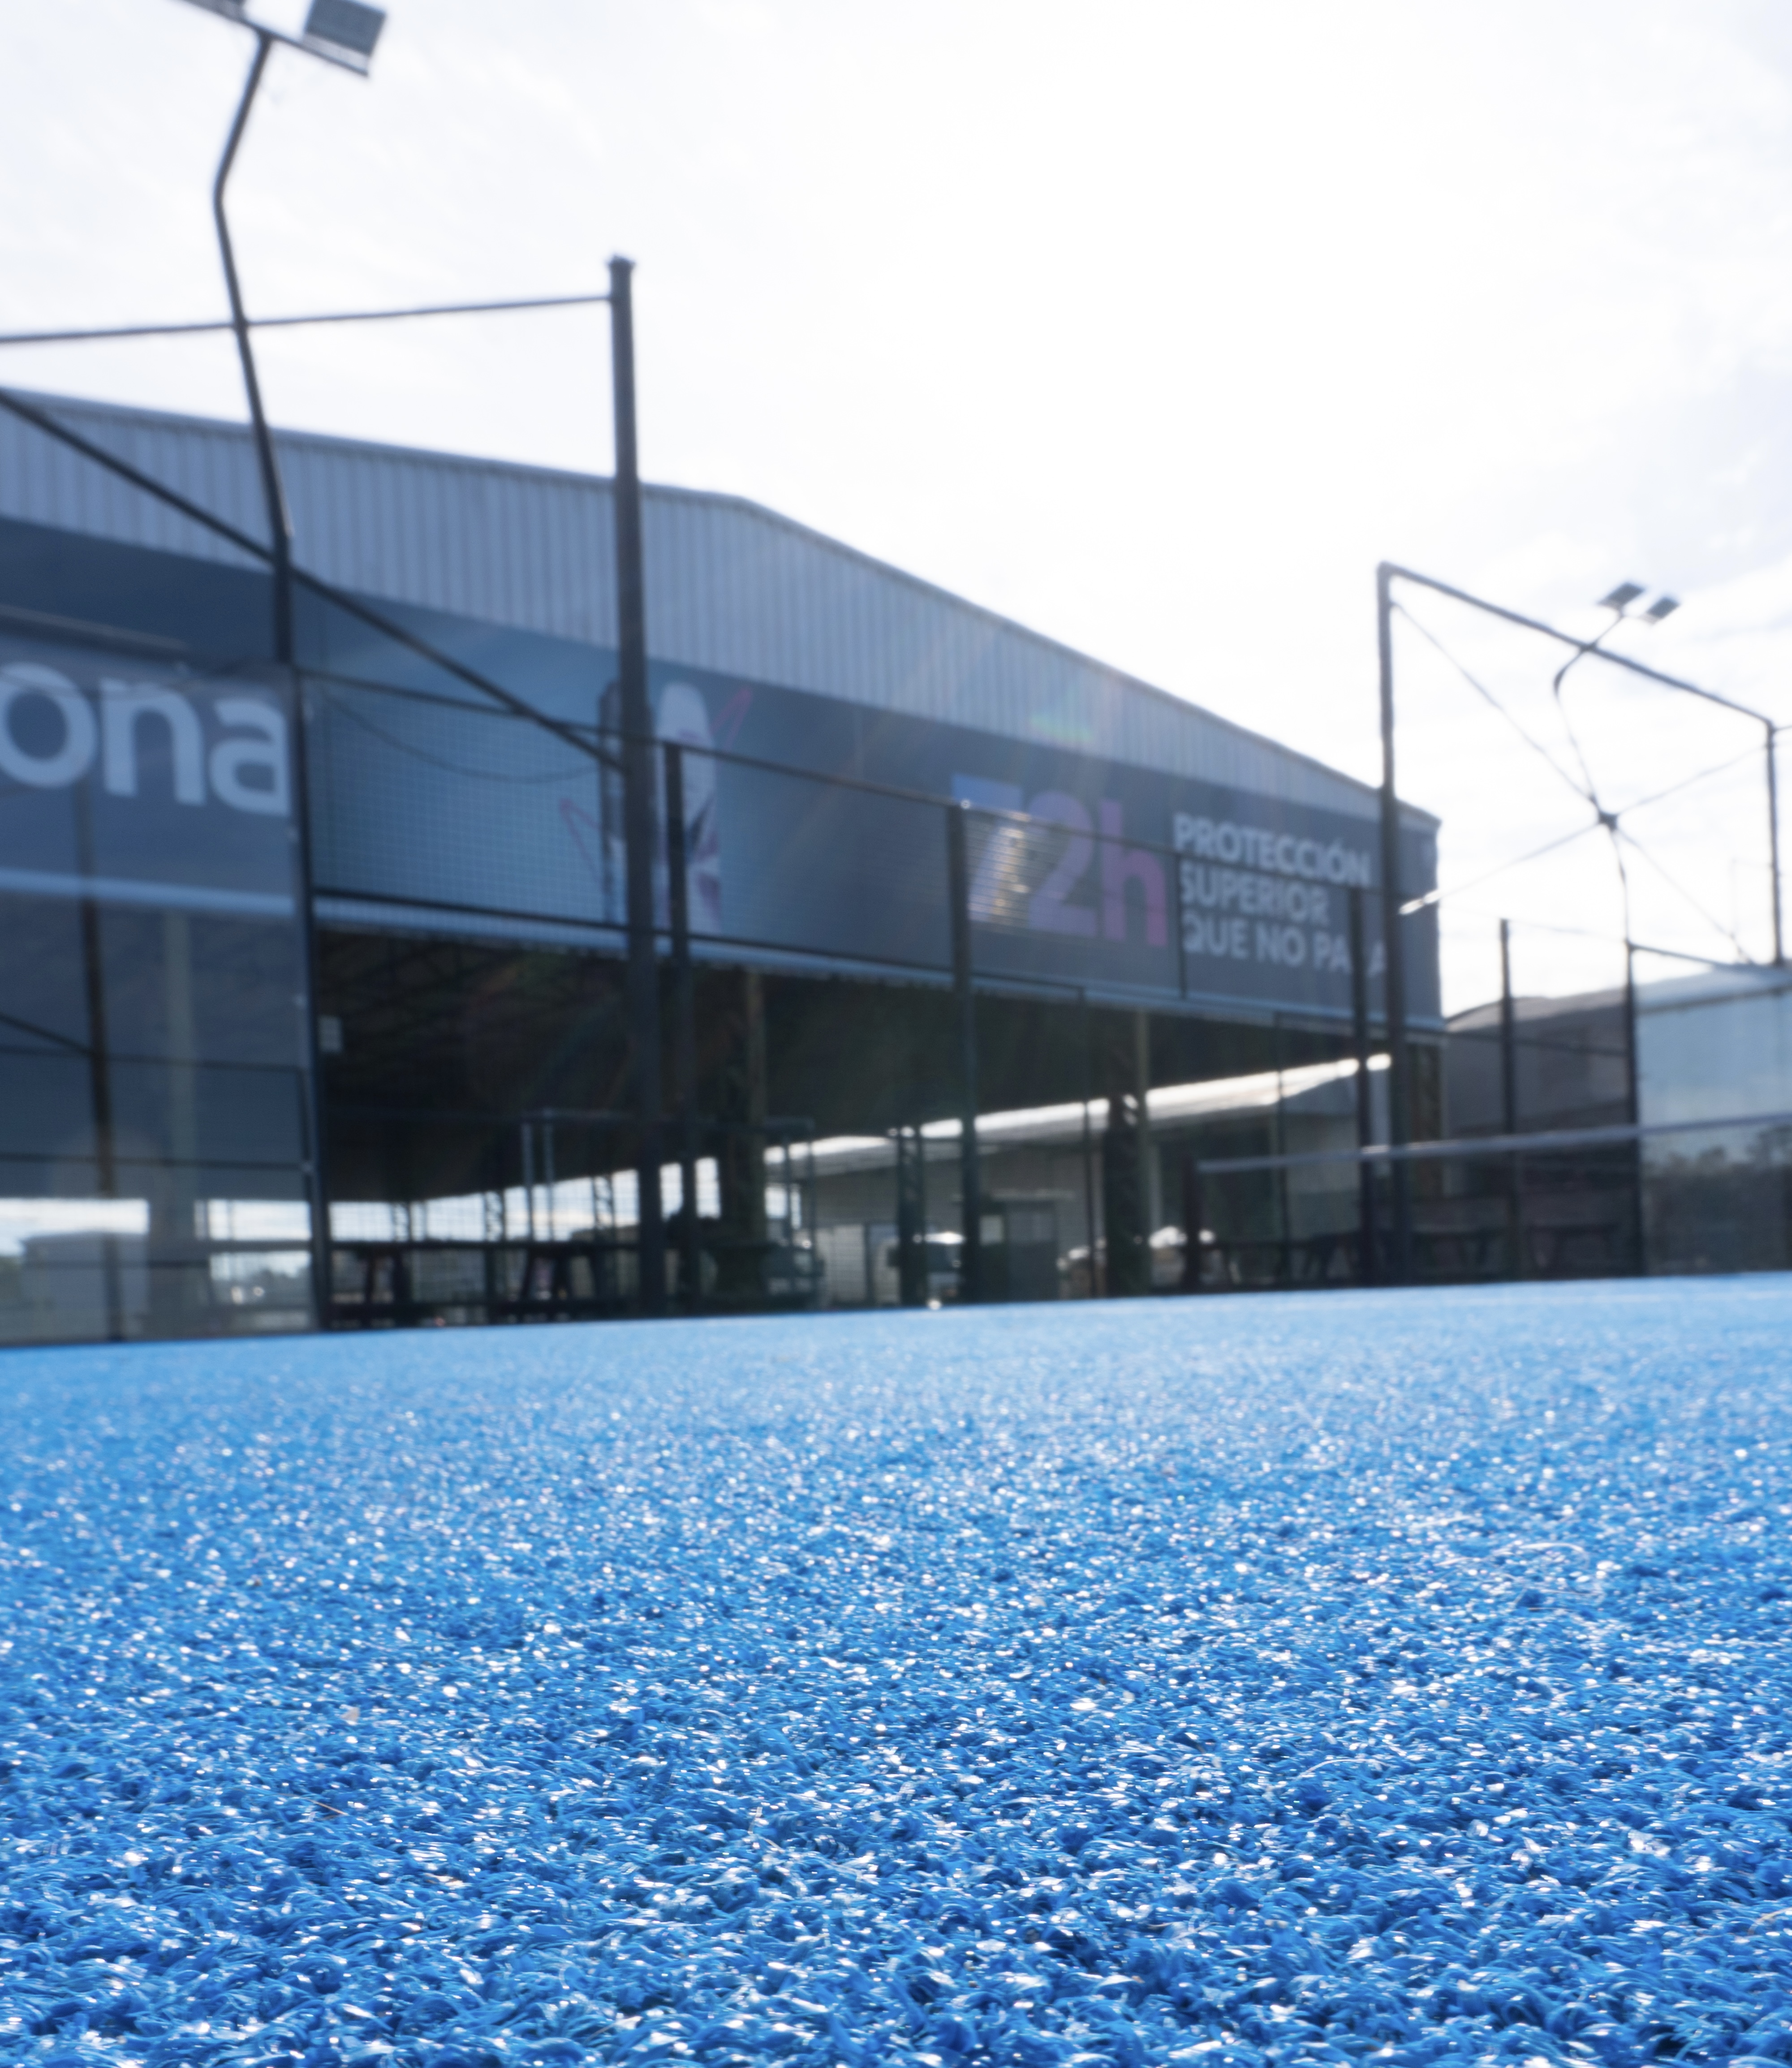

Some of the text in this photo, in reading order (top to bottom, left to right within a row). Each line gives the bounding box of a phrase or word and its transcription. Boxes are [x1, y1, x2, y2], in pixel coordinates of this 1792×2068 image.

[951, 772, 1167, 946] 72h
[1173, 812, 1371, 888] PROTECCIÓN
[1180, 859, 1329, 926] SUPERIOR
[1182, 908, 1387, 978] QUE NO PAA
